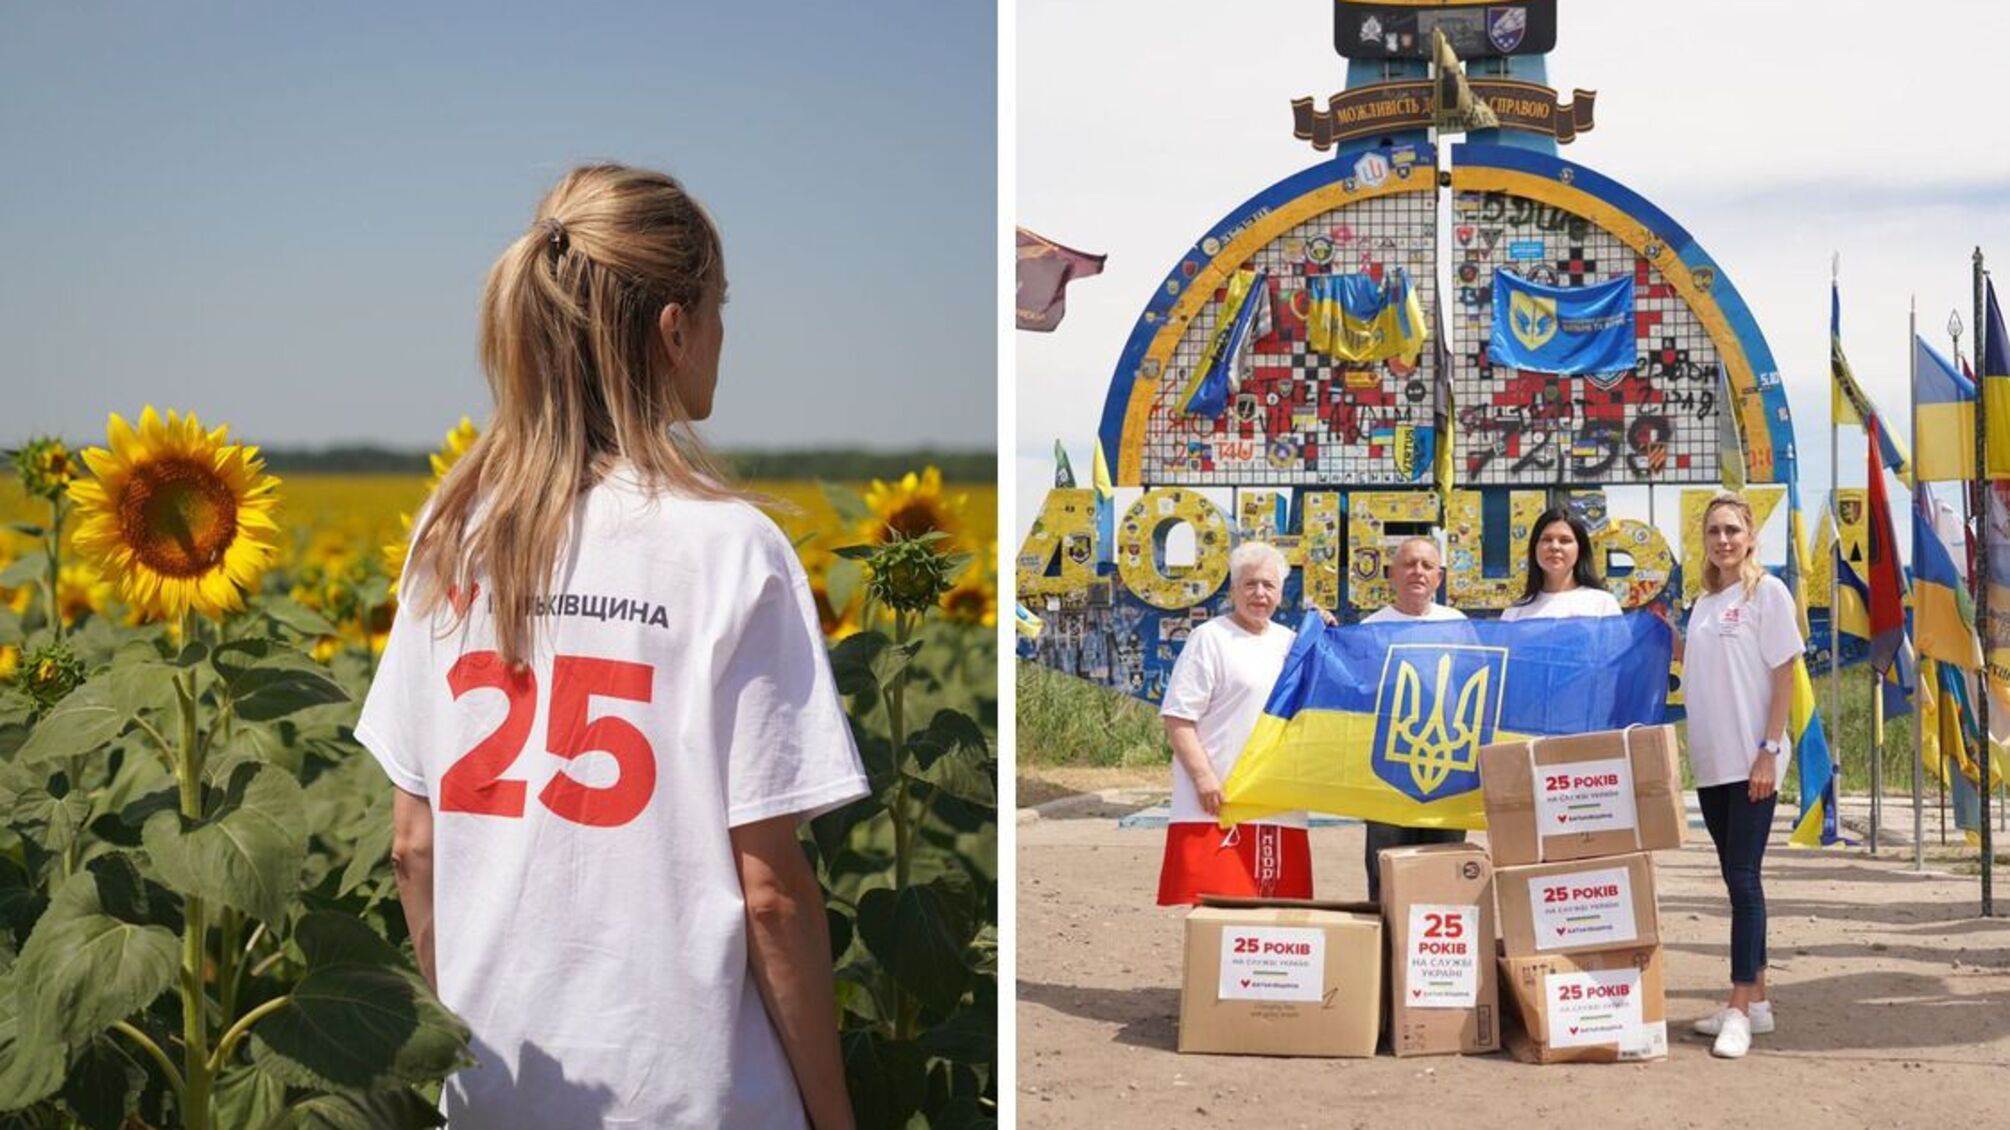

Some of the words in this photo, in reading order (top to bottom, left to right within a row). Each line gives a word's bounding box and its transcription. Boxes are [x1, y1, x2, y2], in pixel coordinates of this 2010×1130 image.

[1337, 97, 1420, 123] МОЖЛИВІСТЬ
[1490, 97, 1550, 118] СПРАВОЮ
[488, 594, 669, 629] ЬКІВЩИНА
[438, 650, 657, 828] 25
[1545, 775, 1570, 791] 25
[1573, 773, 1618, 788] РОКІВ
[1543, 886, 1569, 903] 25
[1572, 884, 1619, 900] РОКІВ
[1424, 913, 1463, 938] 25
[1233, 937, 1260, 953] 25
[1263, 942, 1311, 956] РОКІВ
[1418, 943, 1467, 955] РОКІВ
[1558, 984, 1583, 1001] 25
[1586, 984, 1630, 999] РОКІВ
